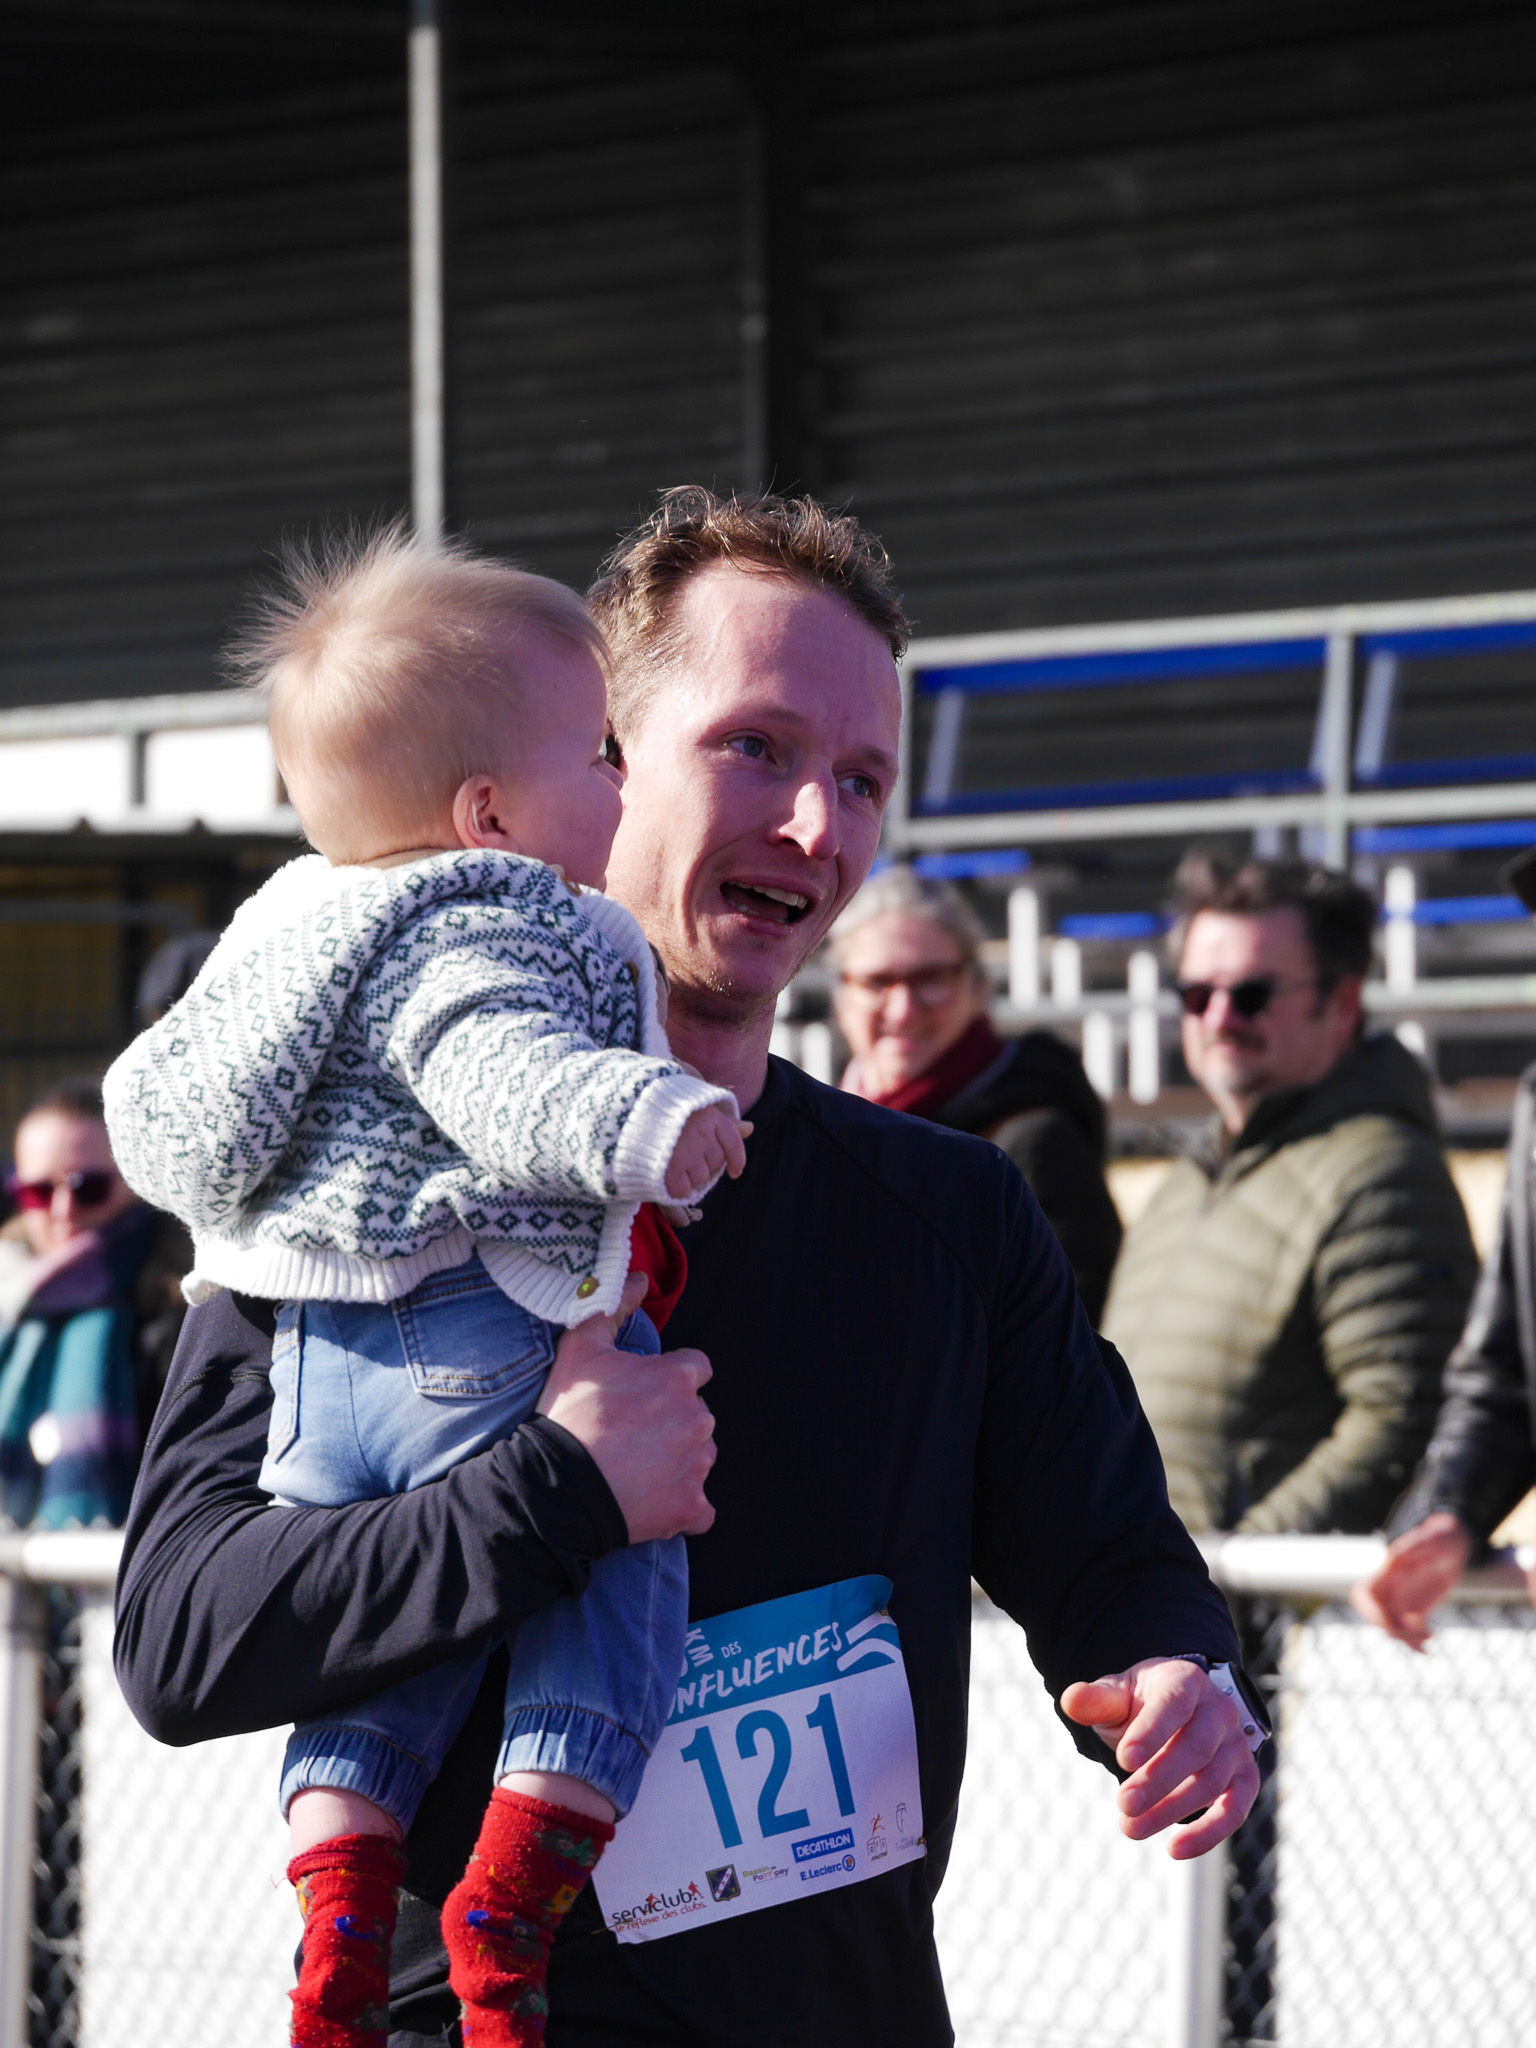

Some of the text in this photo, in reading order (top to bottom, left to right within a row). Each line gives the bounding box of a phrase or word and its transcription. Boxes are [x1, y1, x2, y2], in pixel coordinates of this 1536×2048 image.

[721, 1641, 742, 1659] DES
[680, 1692, 856, 1849] 121
[796, 1833, 852, 1858] DECATHLON
[742, 1866, 770, 1878] Bassin
[800, 1862, 843, 1881] E.Leclerc
[662, 1910, 679, 1920] des
